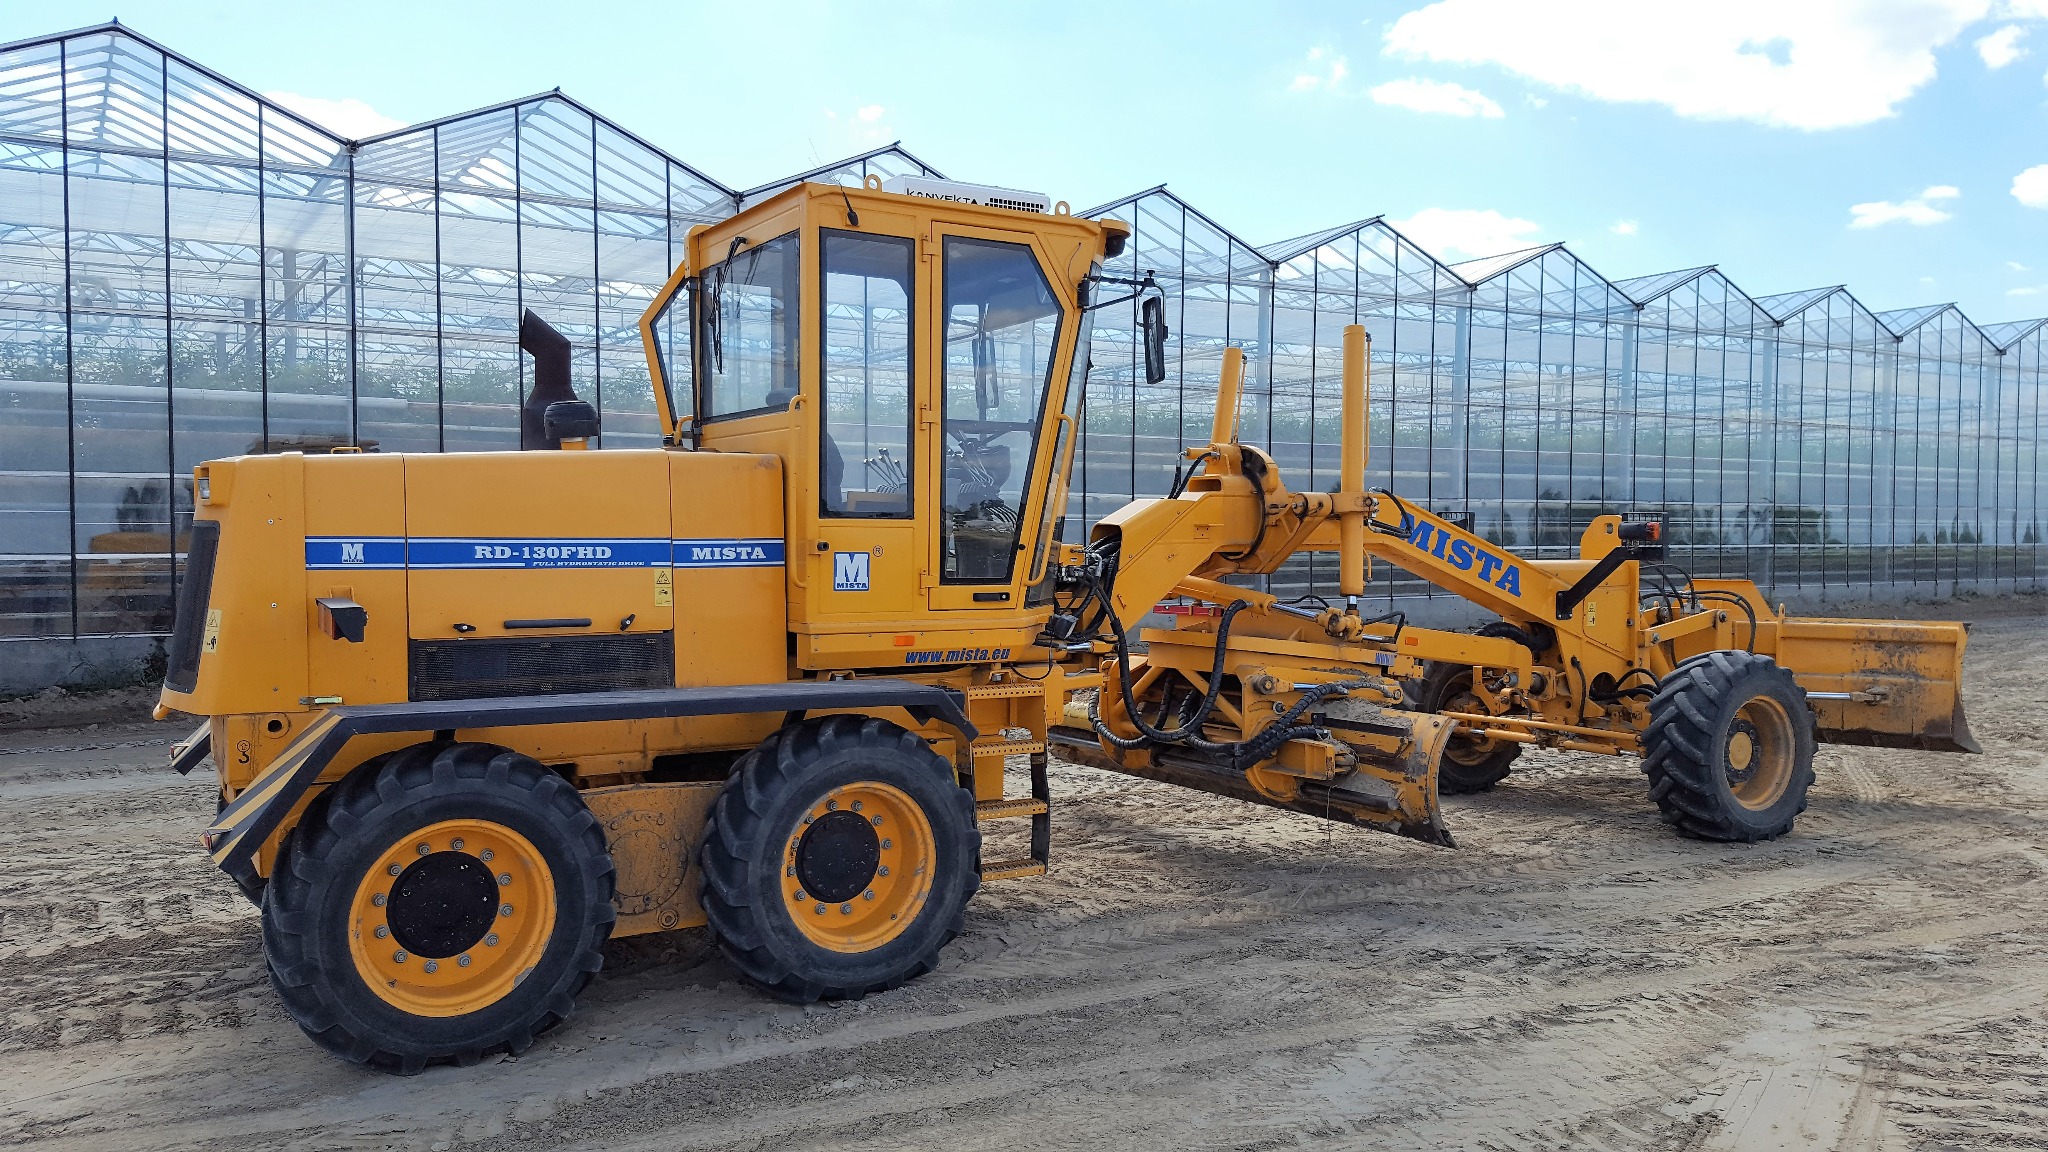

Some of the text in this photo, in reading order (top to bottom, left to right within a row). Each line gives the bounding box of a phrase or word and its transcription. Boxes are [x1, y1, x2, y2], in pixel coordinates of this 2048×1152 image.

[475, 545, 612, 560] RD-130FHD
[691, 546, 767, 561] MISTA
[1399, 511, 1522, 598] MISTA
[835, 553, 869, 582] M
[905, 648, 1011, 664] www.mista.eu
